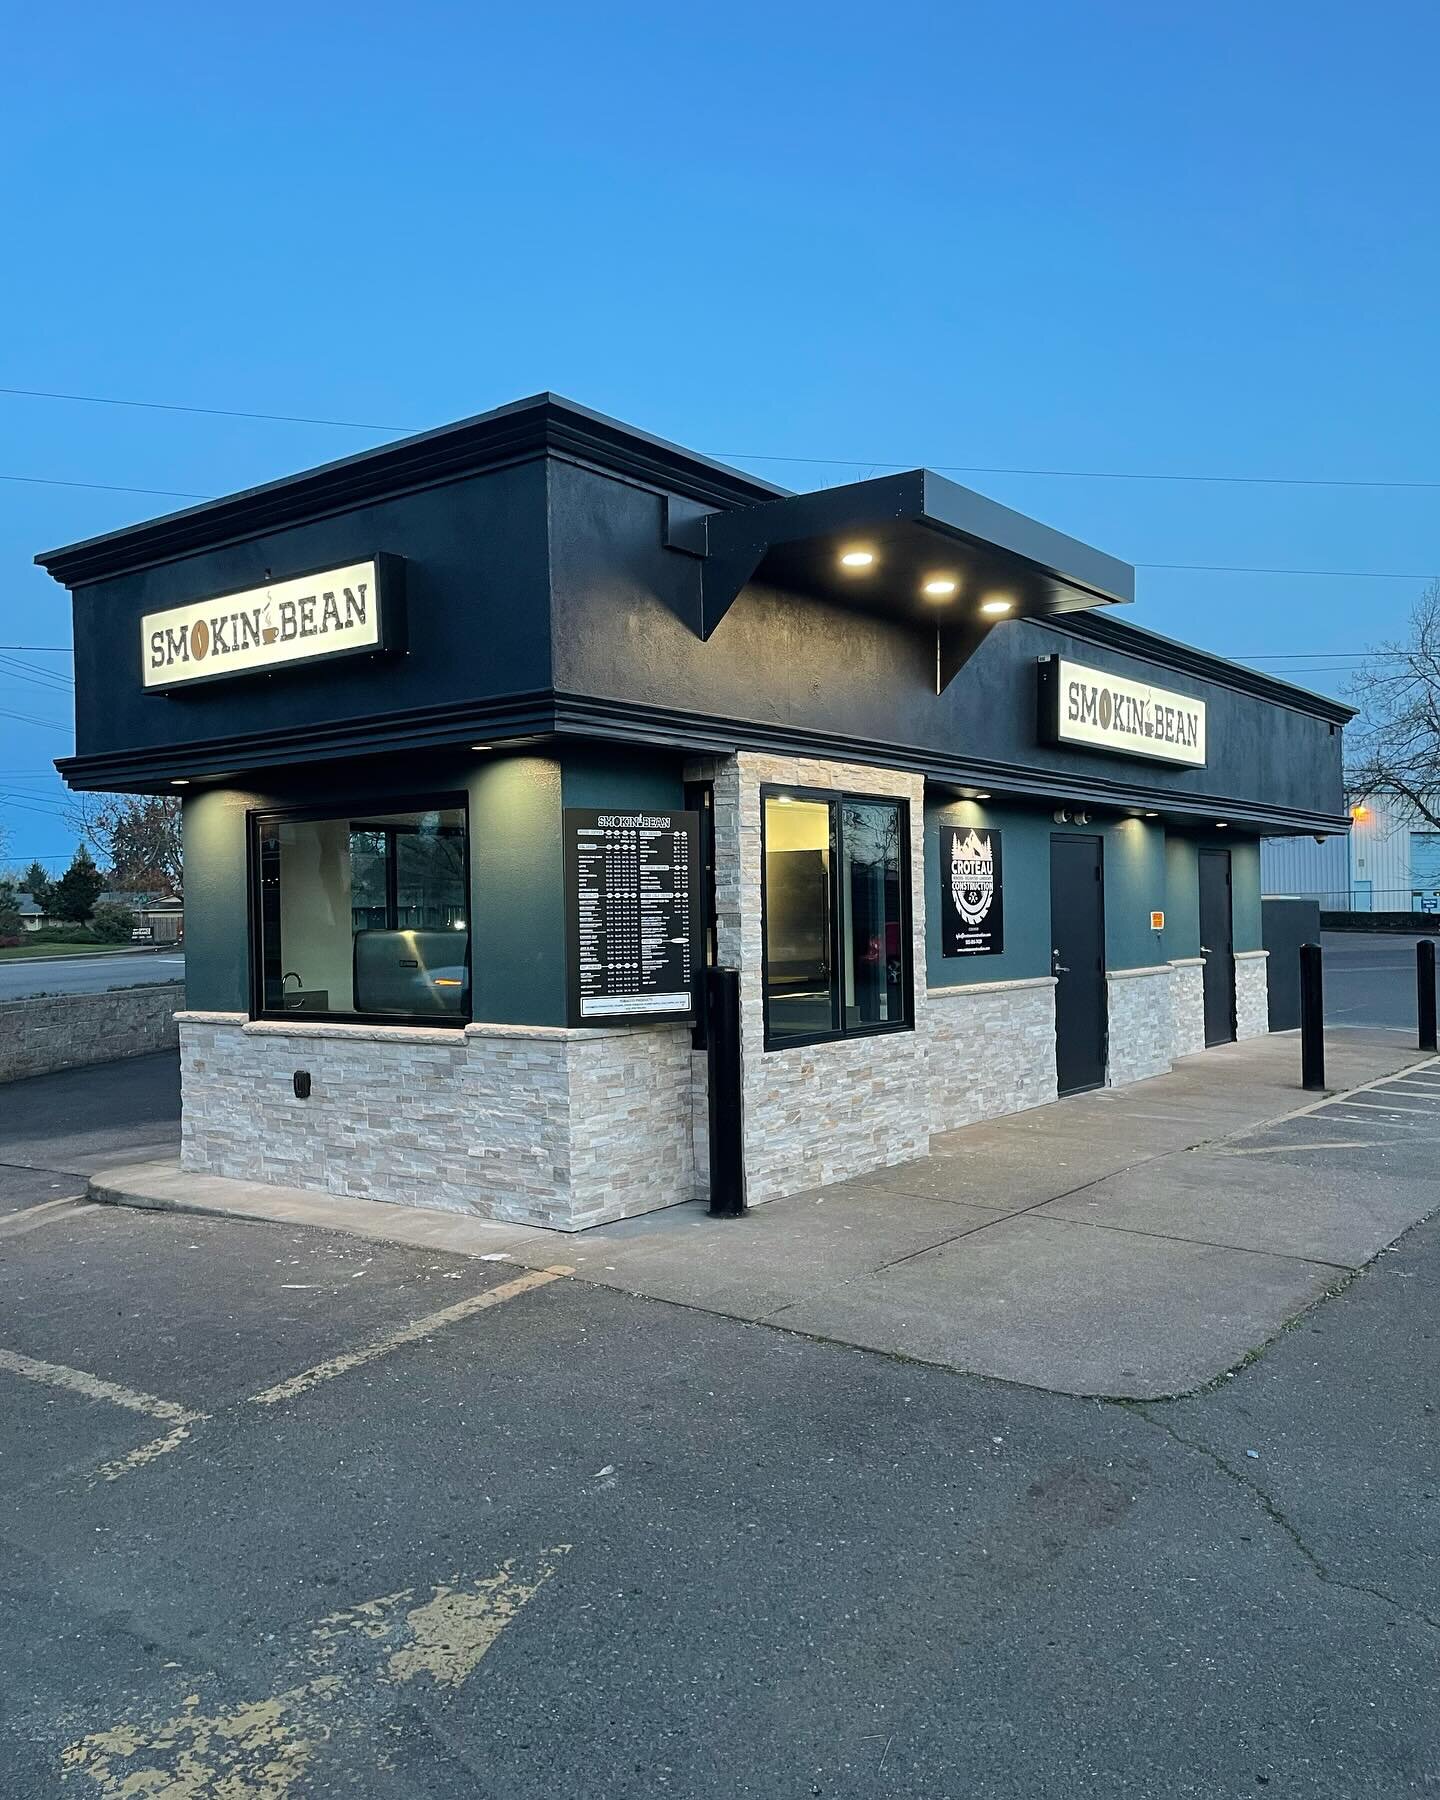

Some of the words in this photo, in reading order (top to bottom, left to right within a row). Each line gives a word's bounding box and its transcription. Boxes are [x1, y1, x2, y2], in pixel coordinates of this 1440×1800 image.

[279, 584, 367, 643] BEAN
[1154, 703, 1198, 748] BEAN
[643, 816, 671, 829] BEAN
[951, 860, 993, 875] CROTEAU
[951, 882, 993, 891] CONSTRUCTION
